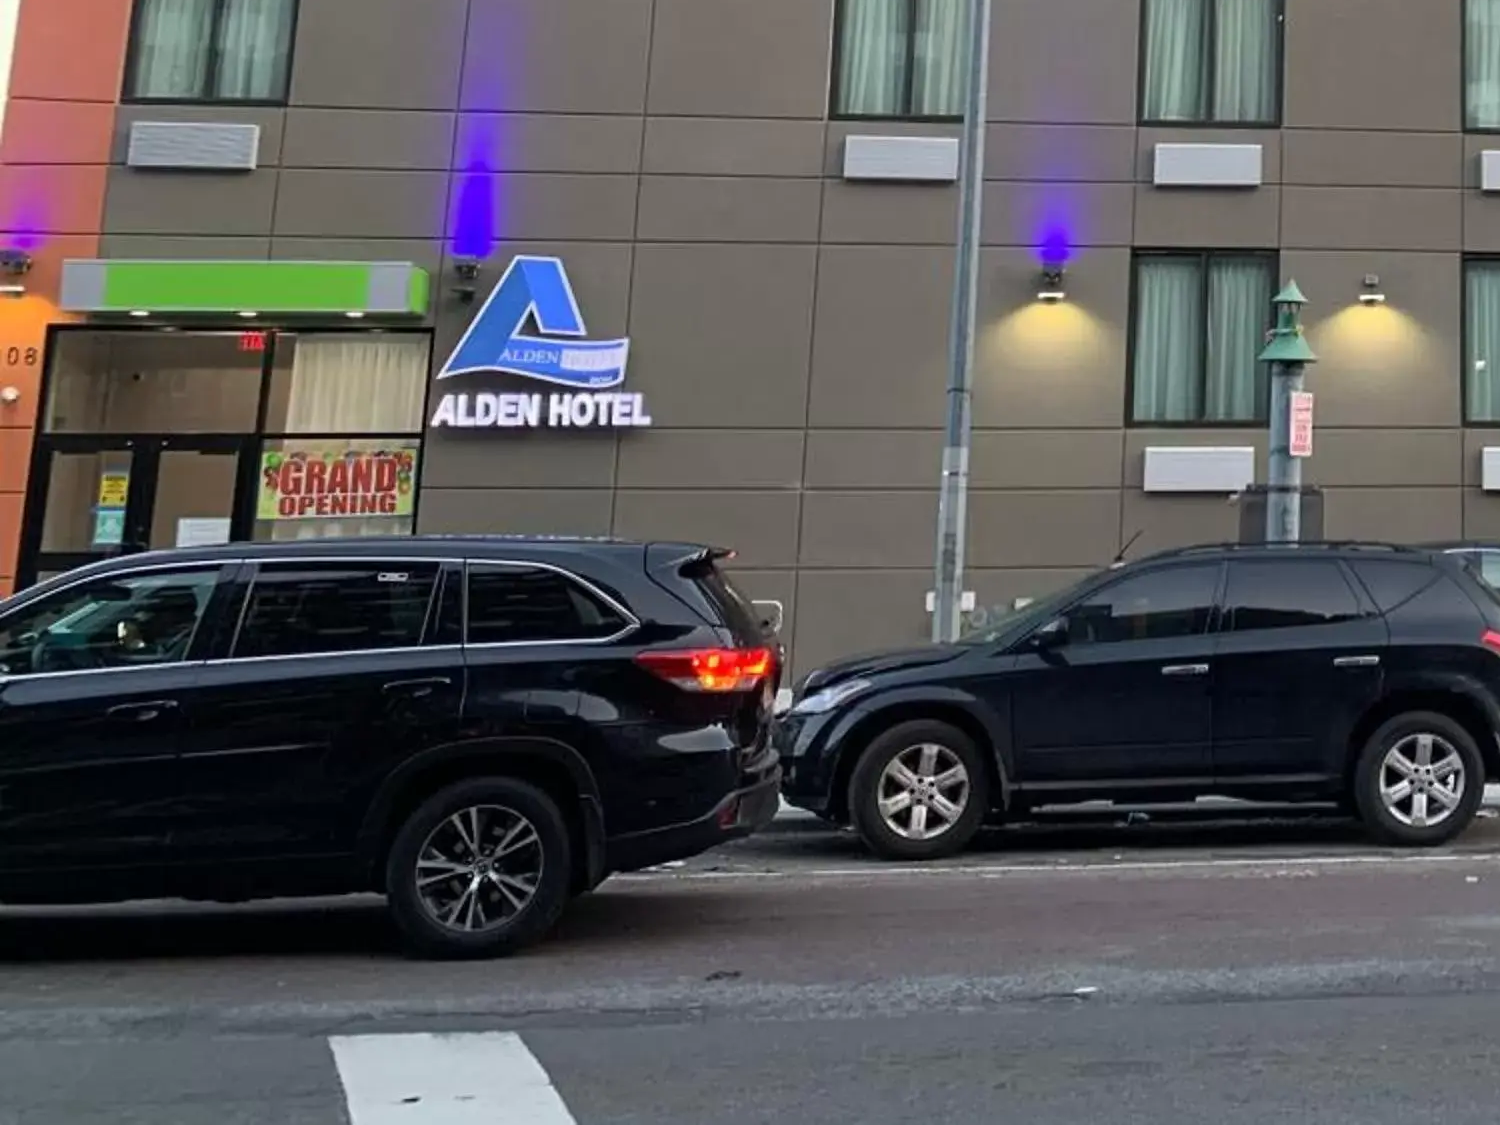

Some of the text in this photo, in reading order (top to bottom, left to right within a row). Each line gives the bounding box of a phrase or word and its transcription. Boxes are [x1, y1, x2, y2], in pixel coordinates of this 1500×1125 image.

[498, 347, 559, 365] ALDEN
[431, 392, 652, 427] ALDEN HOTEL
[279, 458, 398, 495] GRAND
[278, 494, 397, 516] OPENING
